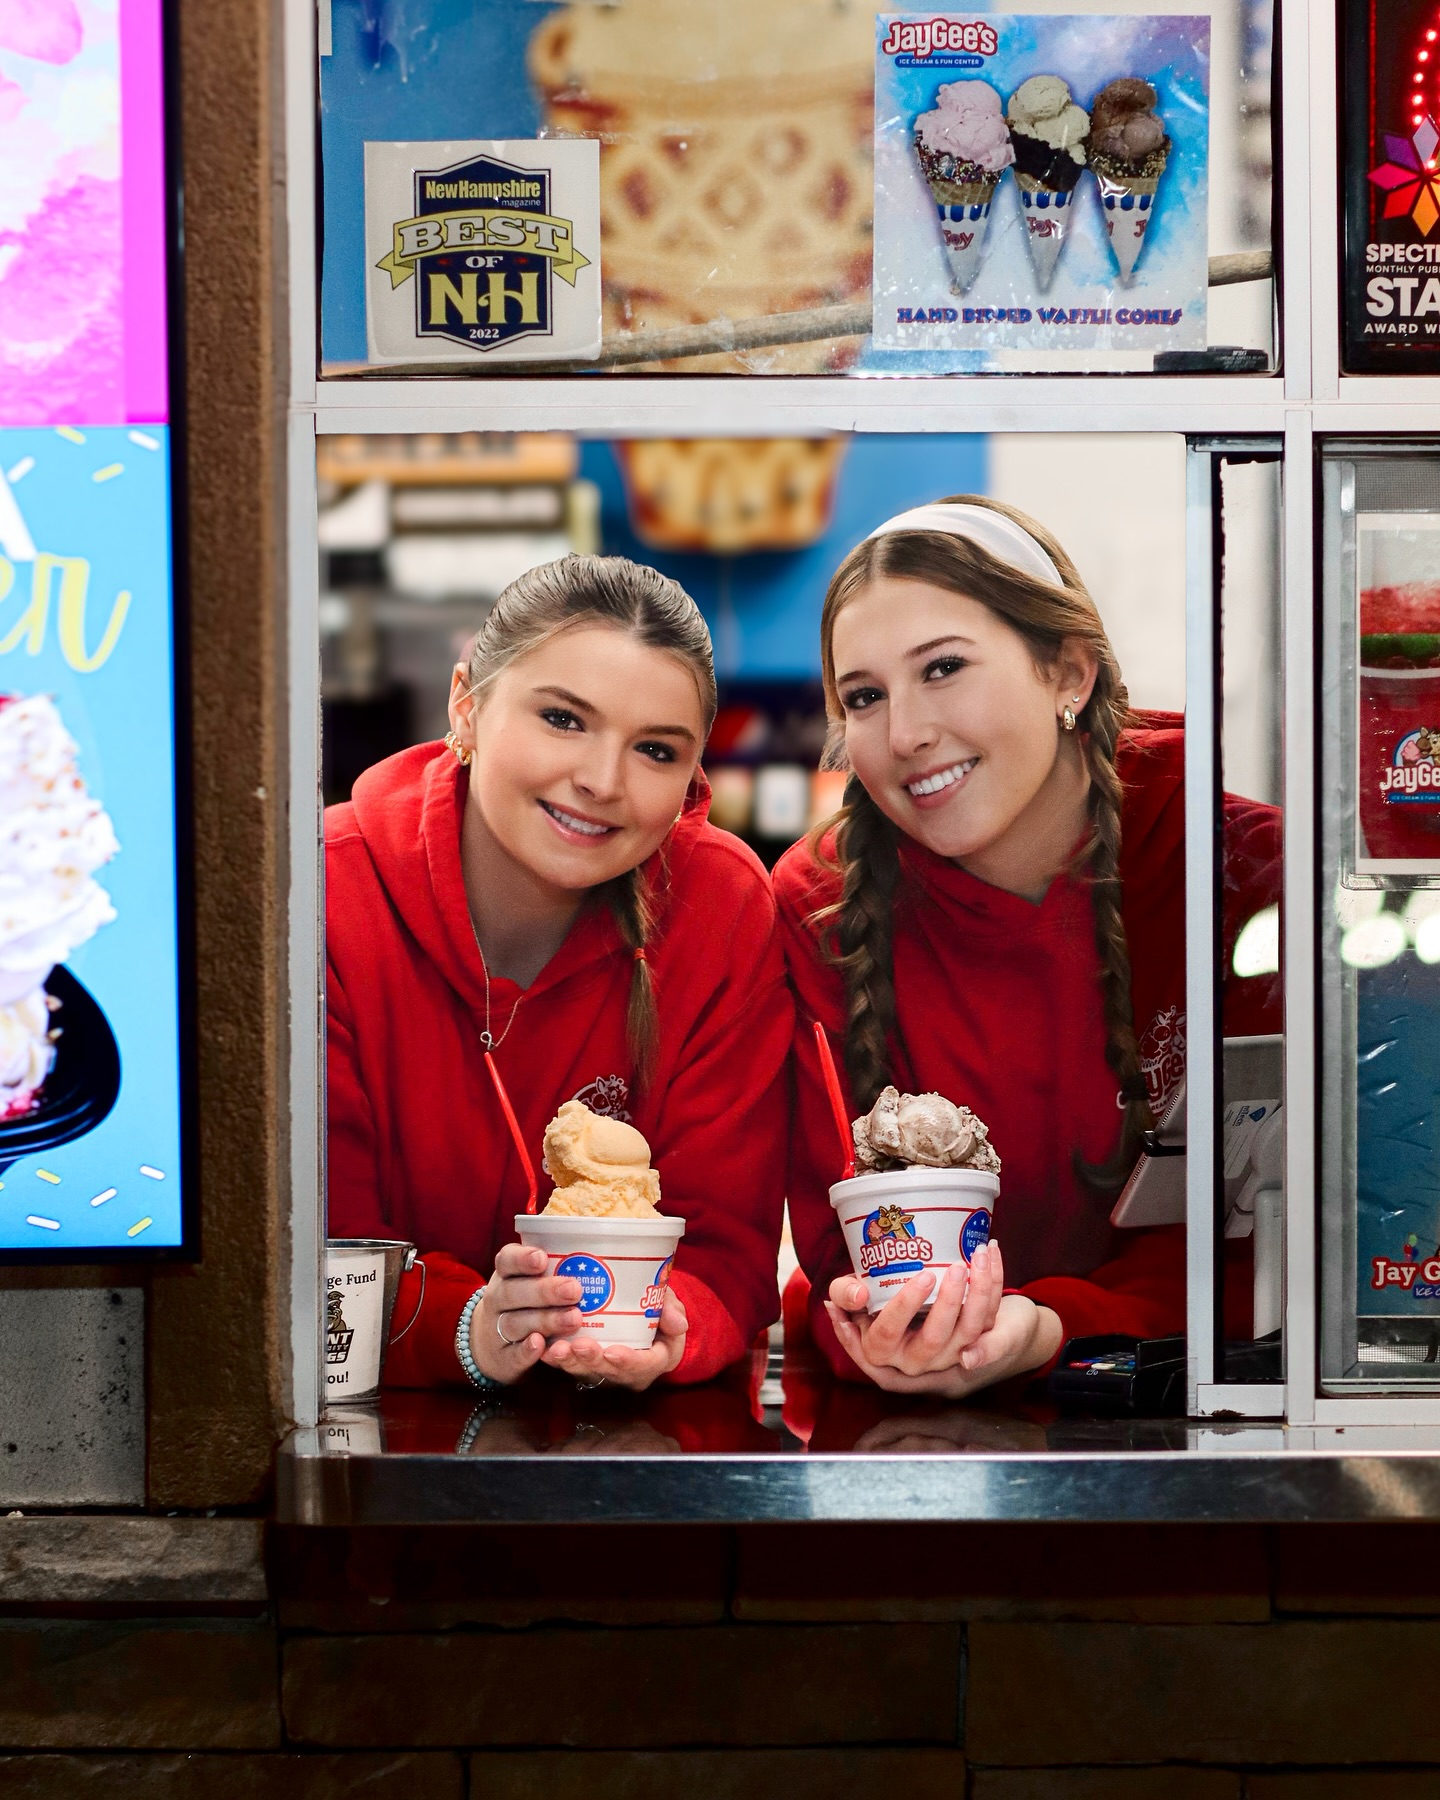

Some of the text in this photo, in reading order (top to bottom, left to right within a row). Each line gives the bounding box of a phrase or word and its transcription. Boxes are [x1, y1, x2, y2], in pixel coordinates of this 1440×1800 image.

[884, 19, 996, 57] JayGee's
[501, 199, 541, 208] magazine
[398, 215, 569, 258] BEST
[465, 256, 503, 268] OF
[1366, 265, 1440, 274] MONTHLY PUB
[427, 272, 542, 325] NH
[1366, 276, 1440, 317] STA
[897, 307, 959, 325] HAND
[1036, 307, 1113, 325] WAFFLE
[1115, 307, 1184, 327] CONES
[469, 328, 500, 340] 2022
[1364, 323, 1419, 335] AWARD
[862, 1237, 932, 1268] JayGee's
[327, 1269, 377, 1291] ge Fund
[573, 1276, 606, 1285] emade
[1375, 1261, 1417, 1287] Jay
[582, 1285, 604, 1294] ream
[327, 1332, 352, 1345] NT
[327, 1351, 347, 1362] GS
[327, 1371, 349, 1384] ou!
